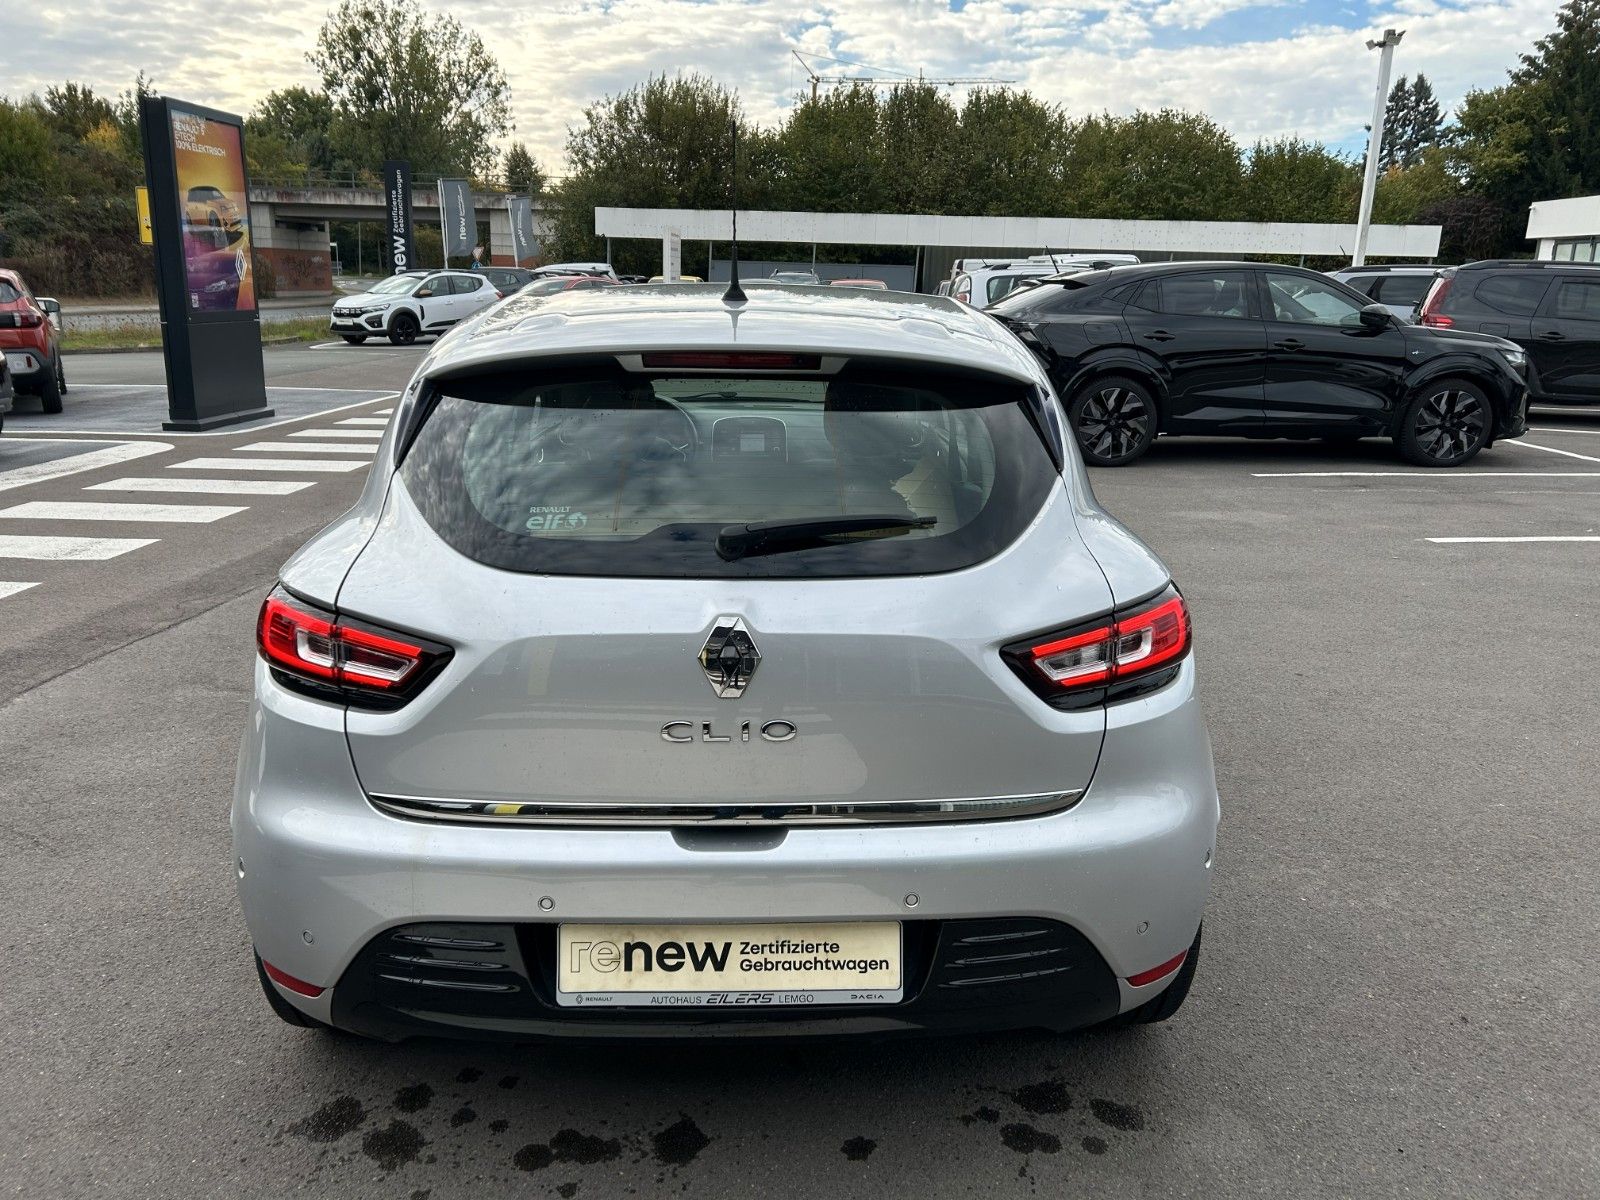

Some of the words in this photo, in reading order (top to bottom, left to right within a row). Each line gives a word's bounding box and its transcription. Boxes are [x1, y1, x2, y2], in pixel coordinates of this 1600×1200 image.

[175, 139, 191, 151] 100%
[192, 143, 226, 157] ELEKTRISCH
[396, 169, 404, 233] Gebrauchtwagen
[391, 190, 399, 233] Zertifizierte
[526, 514, 566, 530] elf
[661, 719, 798, 743] CLIO
[739, 939, 840, 955] Zertifizierte
[570, 940, 733, 973] renew
[739, 957, 890, 974] Gebrauchtwagen
[650, 995, 702, 1005] AUTOHAUS
[706, 993, 775, 1004] EILERS
[778, 994, 815, 1004] LEMGO
